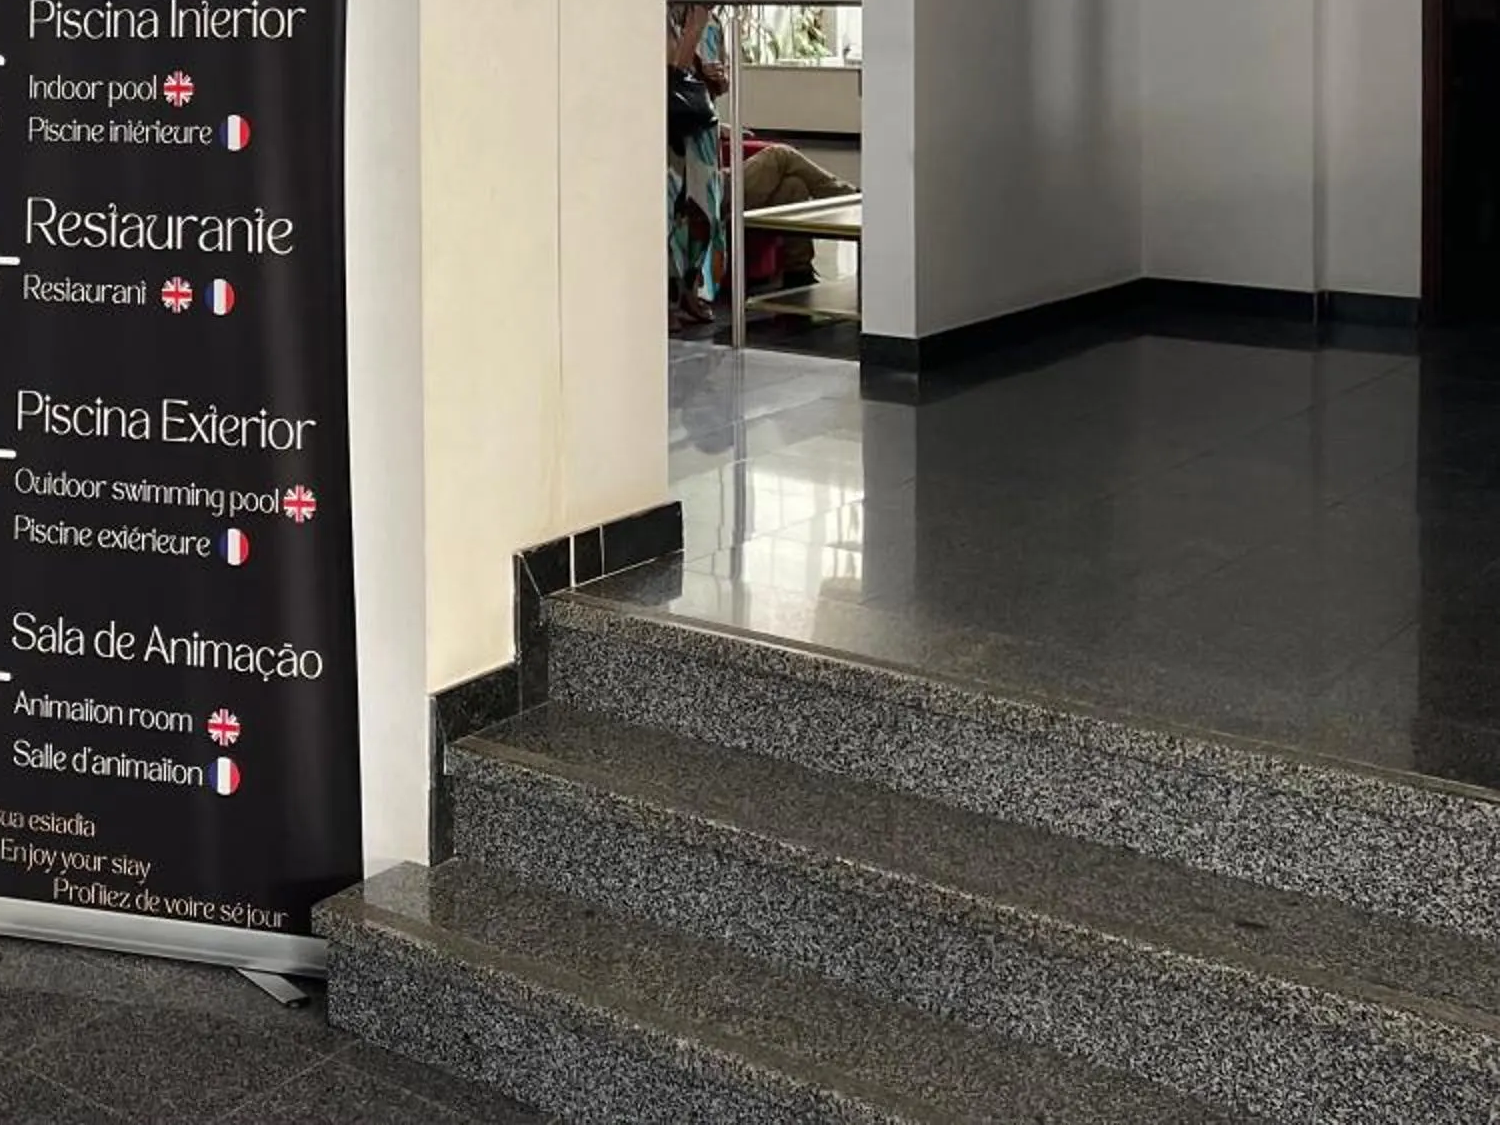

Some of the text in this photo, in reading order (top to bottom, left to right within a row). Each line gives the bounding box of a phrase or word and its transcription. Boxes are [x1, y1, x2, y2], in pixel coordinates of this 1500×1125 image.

[29, 74, 157, 108] Indoor pool
[29, 116, 213, 145] Piscine intérieure
[26, 196, 294, 255] Restaurante
[23, 274, 147, 305] Restaurant
[17, 390, 317, 450] Piscina Exterior
[14, 467, 279, 517] Outdoor swimming pool
[13, 514, 211, 557] Piscine extérieure
[11, 612, 323, 682] Sala de Animação
[13, 690, 193, 733] Animation room
[12, 739, 203, 786] Salle d'animation
[28, 811, 96, 838] estadia
[0, 838, 152, 885] Enjoy your stay
[135, 888, 161, 913] de
[164, 894, 216, 920] votre
[219, 902, 289, 930] séjour
